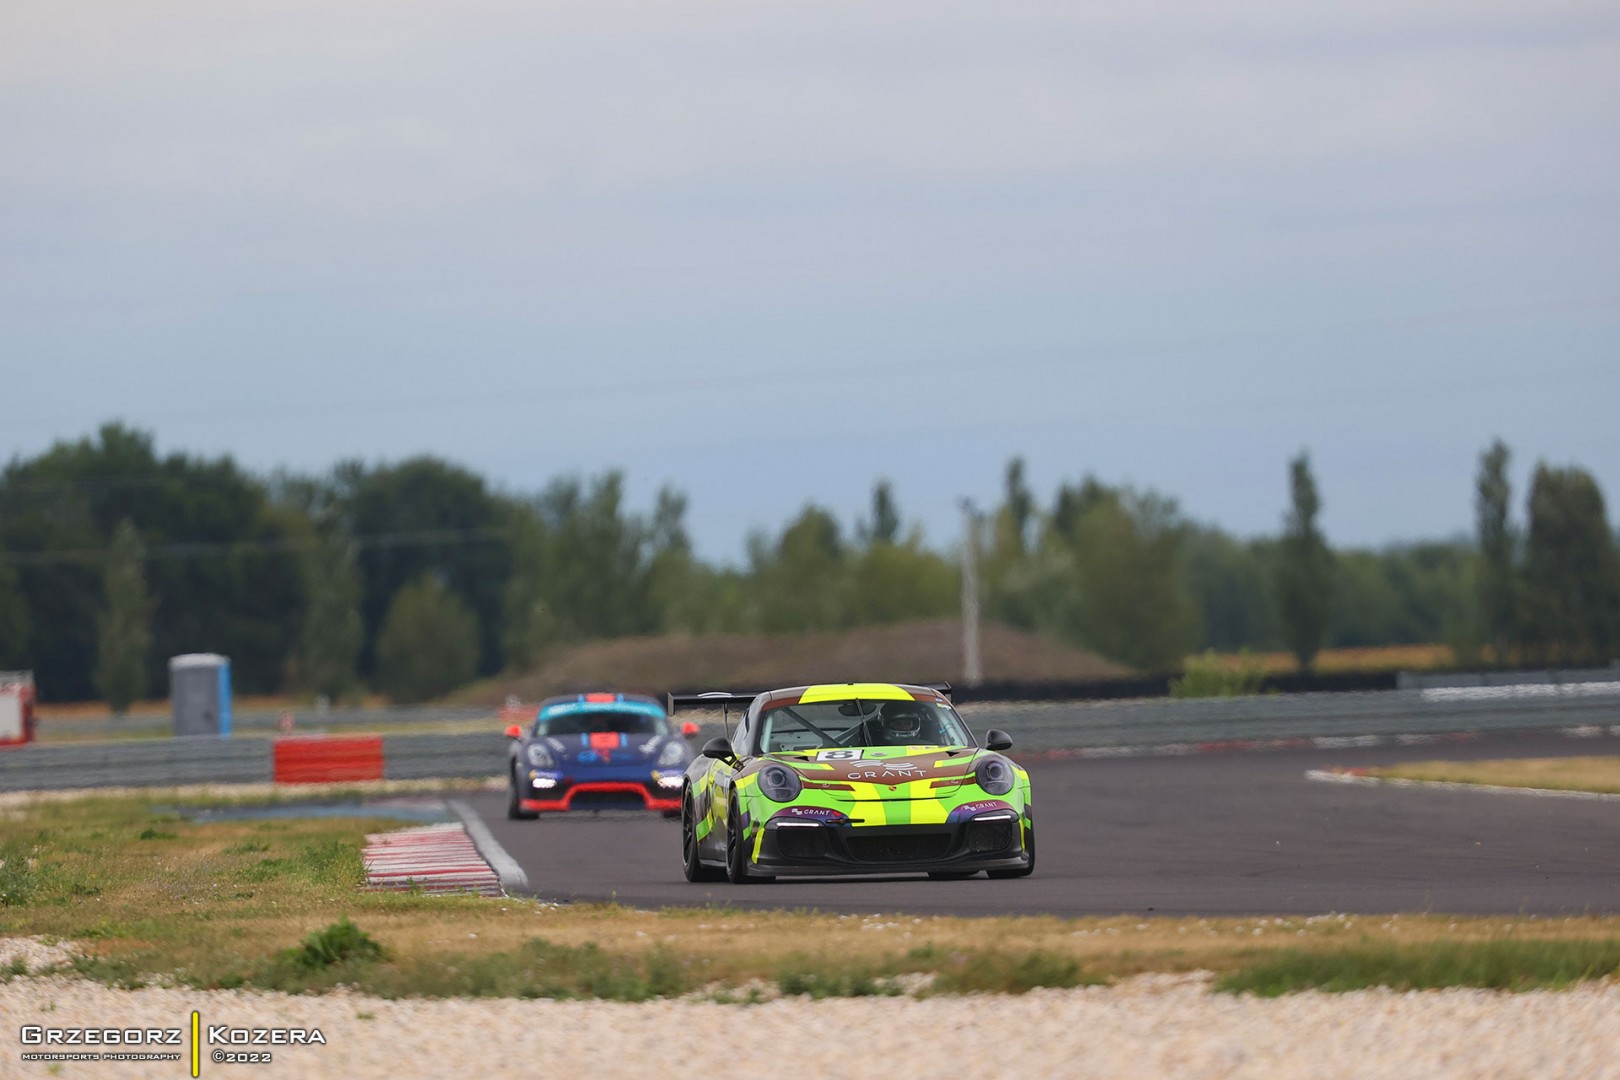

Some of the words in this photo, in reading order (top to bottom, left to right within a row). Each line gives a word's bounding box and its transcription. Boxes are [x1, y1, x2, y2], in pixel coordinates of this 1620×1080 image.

[825, 750, 853, 760] 8
[848, 770, 927, 780] GRANT
[975, 802, 998, 810] GRANT
